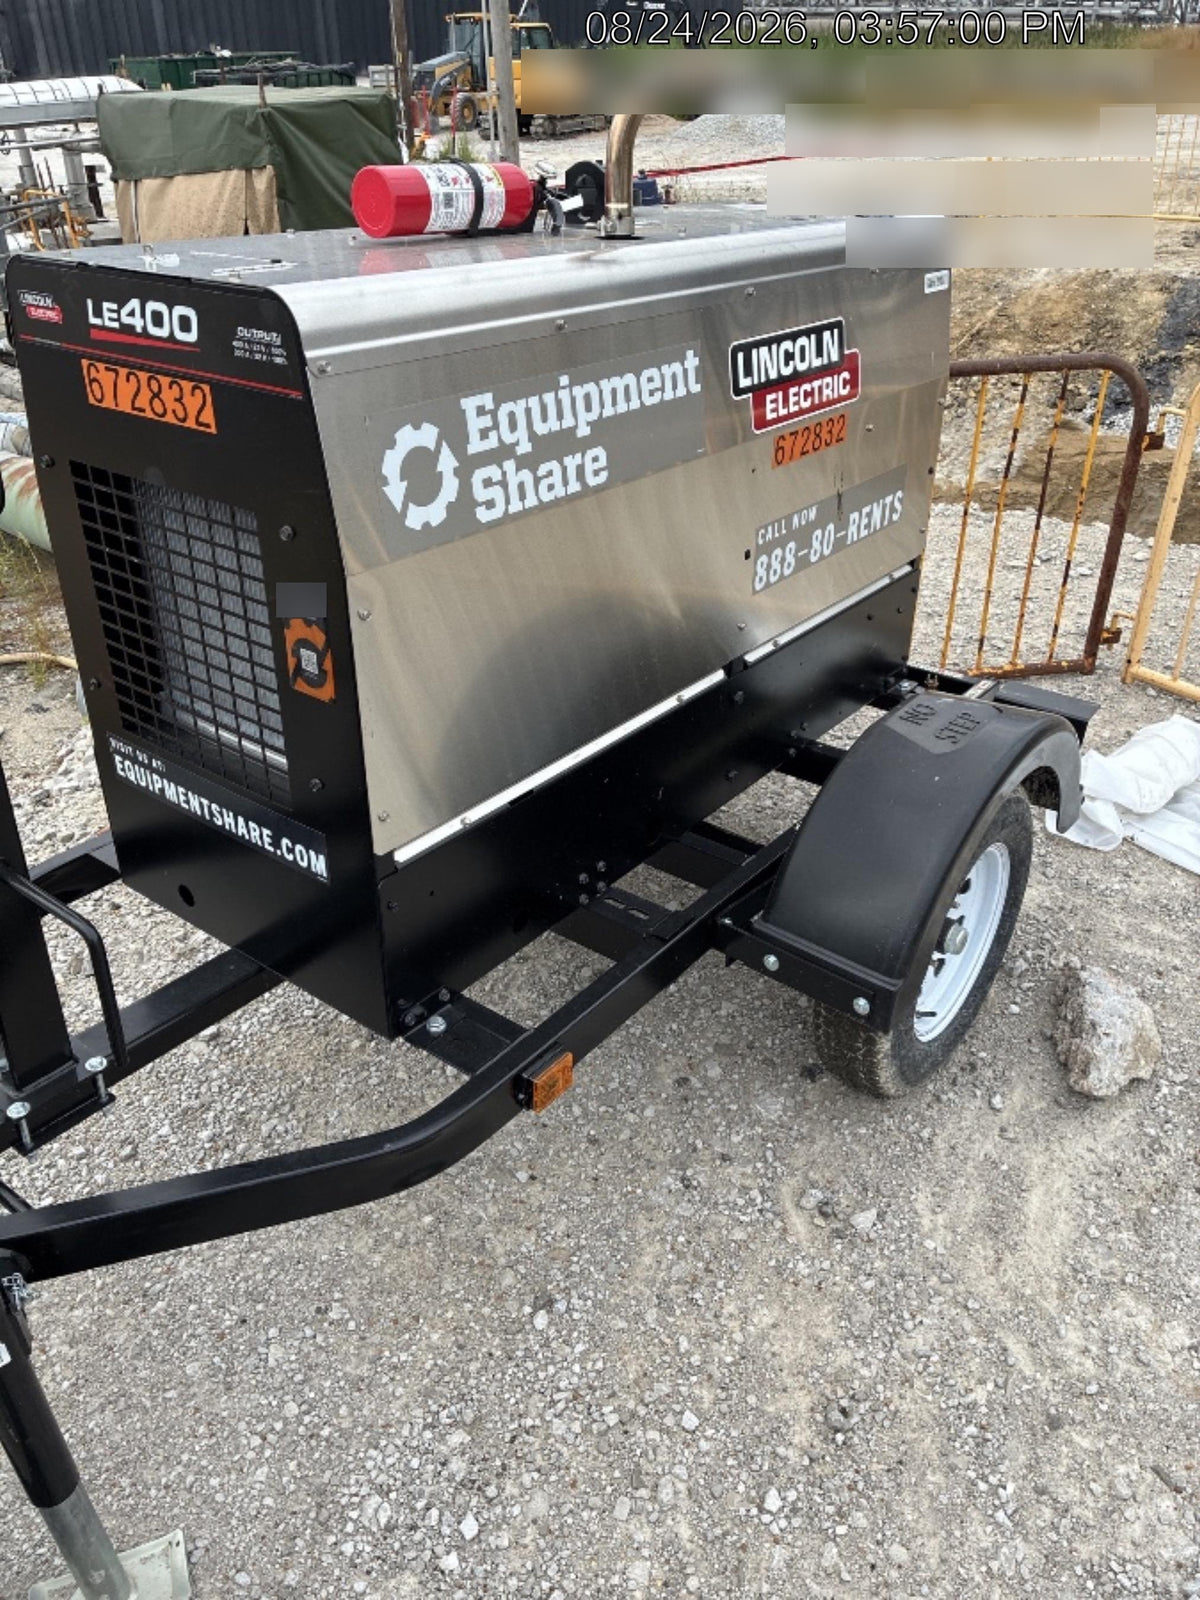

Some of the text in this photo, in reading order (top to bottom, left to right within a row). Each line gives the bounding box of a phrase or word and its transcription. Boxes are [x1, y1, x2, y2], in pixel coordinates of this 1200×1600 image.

[87, 298, 198, 342] LE400
[737, 328, 839, 388] LINCOLN
[86, 361, 212, 430] 672832
[460, 349, 702, 456] Equipment
[766, 371, 851, 421] ELECTRIC
[774, 413, 847, 466] 672832
[471, 446, 609, 523] Share
[754, 490, 905, 591] 888-80-RENTS
[758, 504, 819, 545] CALL NOW
[899, 703, 937, 726] NO
[935, 711, 981, 744] STEP
[113, 753, 328, 878] EQUIPMENTSHARE.COM
